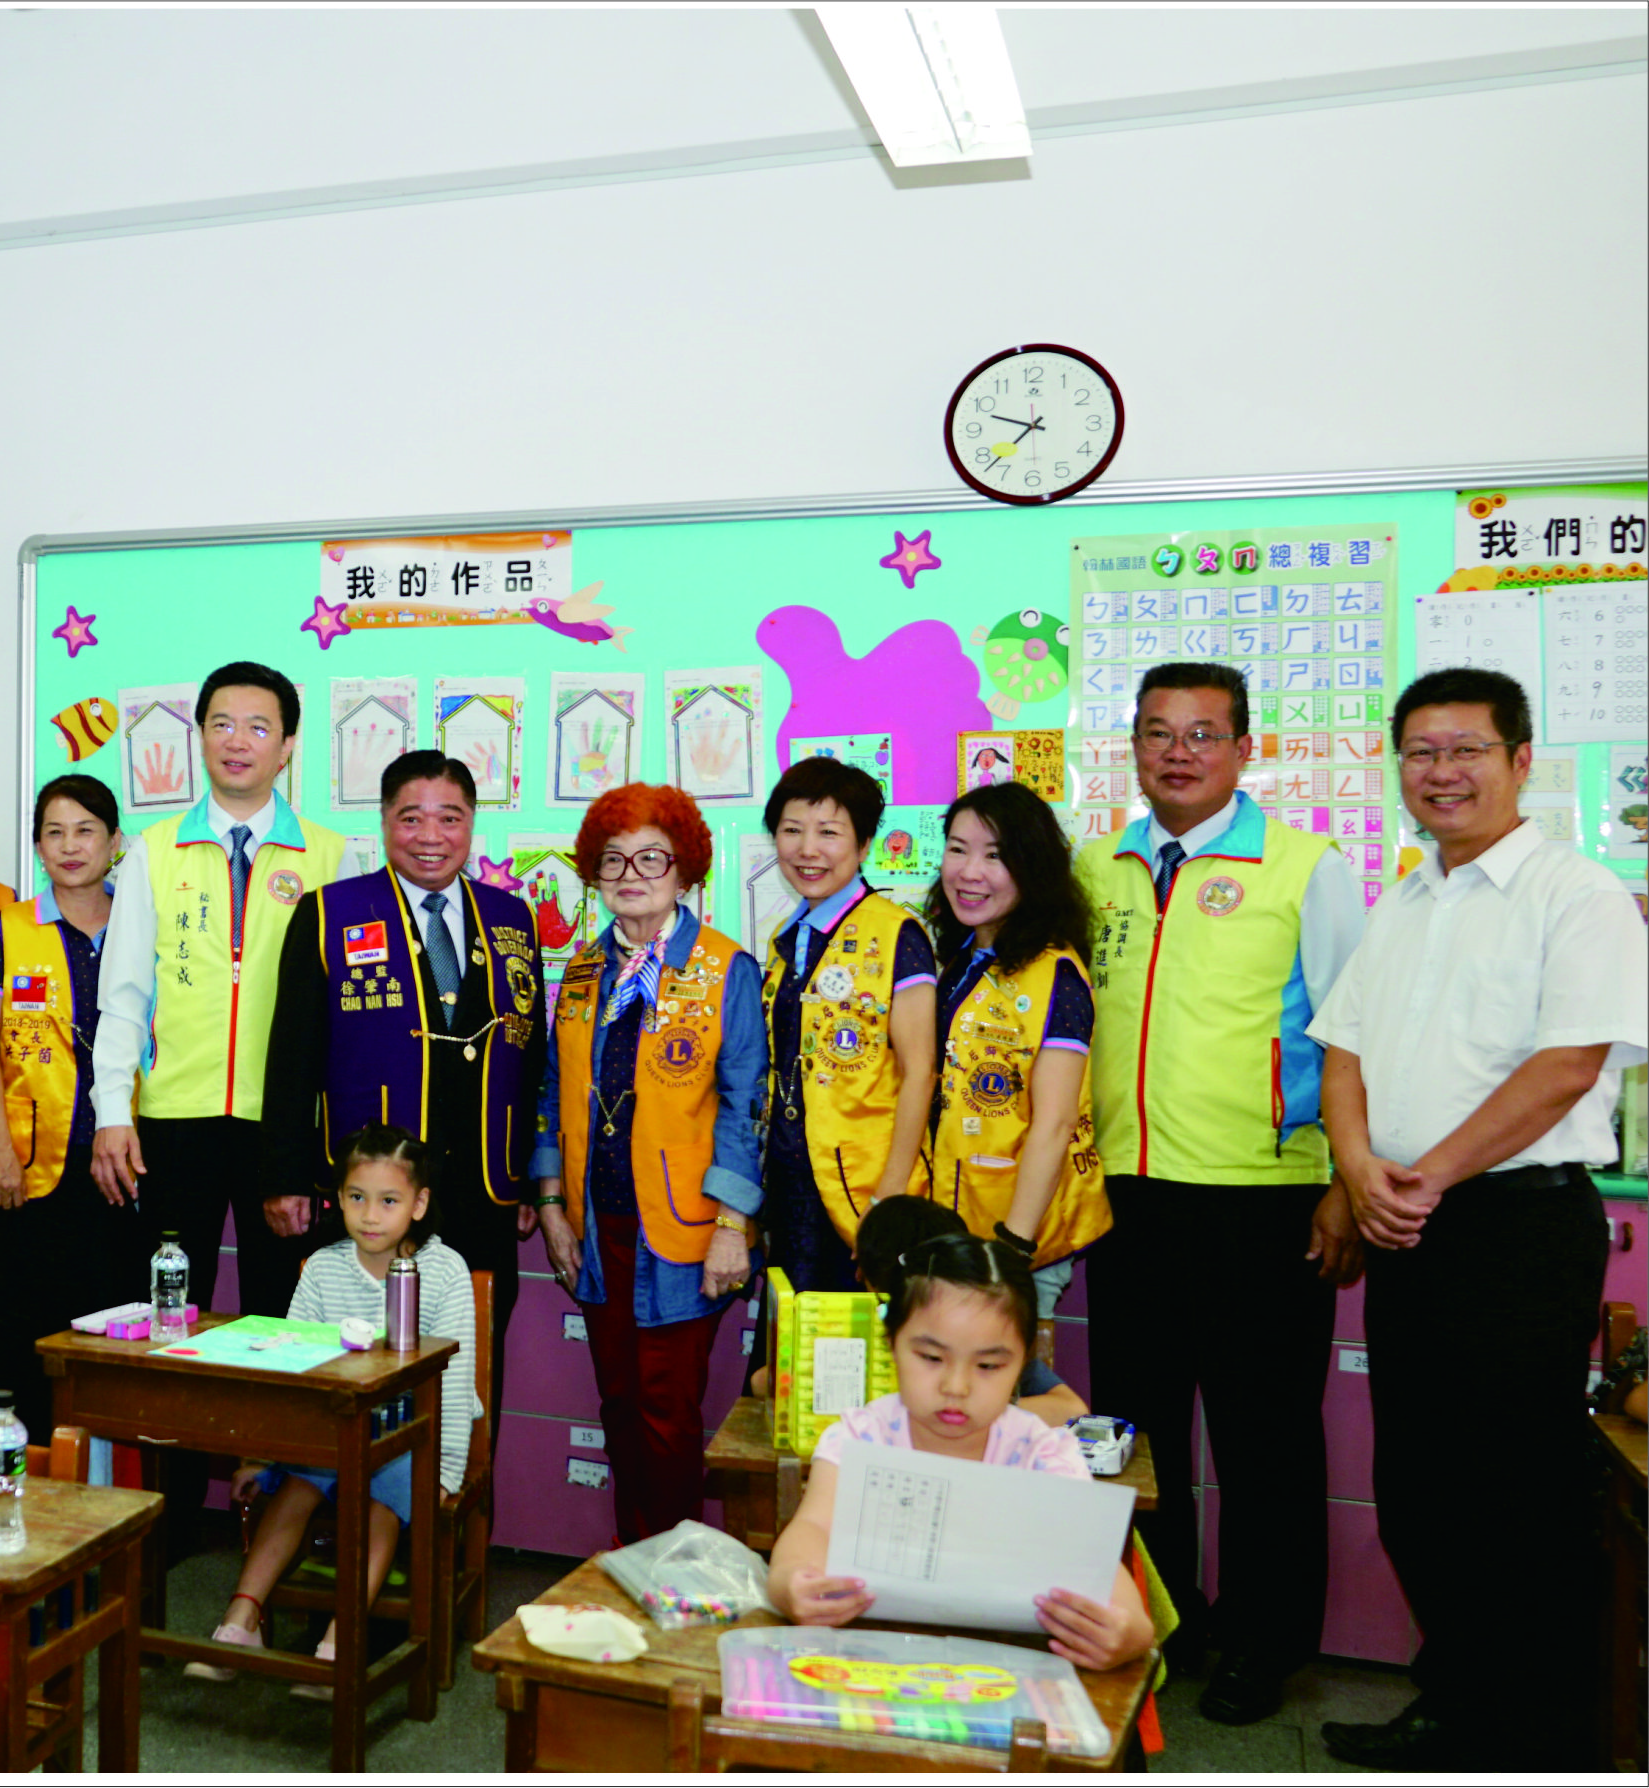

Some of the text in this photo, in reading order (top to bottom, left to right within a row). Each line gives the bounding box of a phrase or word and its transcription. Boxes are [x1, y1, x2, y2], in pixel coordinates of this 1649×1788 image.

[1023, 366, 1044, 384] 12
[1060, 373, 1067, 390] 1
[994, 379, 1010, 394] 11
[975, 396, 996, 412] 10
[1074, 389, 1091, 406] 2
[965, 422, 982, 439] 9
[1085, 415, 1102, 432] 3
[975, 447, 991, 464] 8
[1077, 441, 1093, 457] 4
[997, 465, 1012, 482] 7
[1054, 461, 1071, 478] 5
[1024, 470, 1042, 487] 6
[1479, 514, 1646, 559] 我們的
[346, 560, 534, 599] 我的作品
[1594, 610, 1604, 621] 6
[1594, 634, 1604, 646] 7
[1594, 659, 1604, 671] 8
[1592, 681, 1602, 699] 9
[1589, 708, 1605, 720] 10
[175, 911, 193, 987] 陳志成
[354, 950, 380, 961] TAIWAN
[350, 964, 388, 980] 總監
[340, 977, 401, 996] 徐肇南
[340, 993, 404, 1011] CHAO NAN HSU
[840, 1030, 853, 1048] L
[671, 1041, 687, 1062] L
[815, 1046, 838, 1070] QUEEN
[840, 1062, 868, 1073] LIONS
[988, 1075, 1000, 1093] L
[983, 1107, 1011, 1118] LIONS
[581, 1431, 593, 1443] 15
